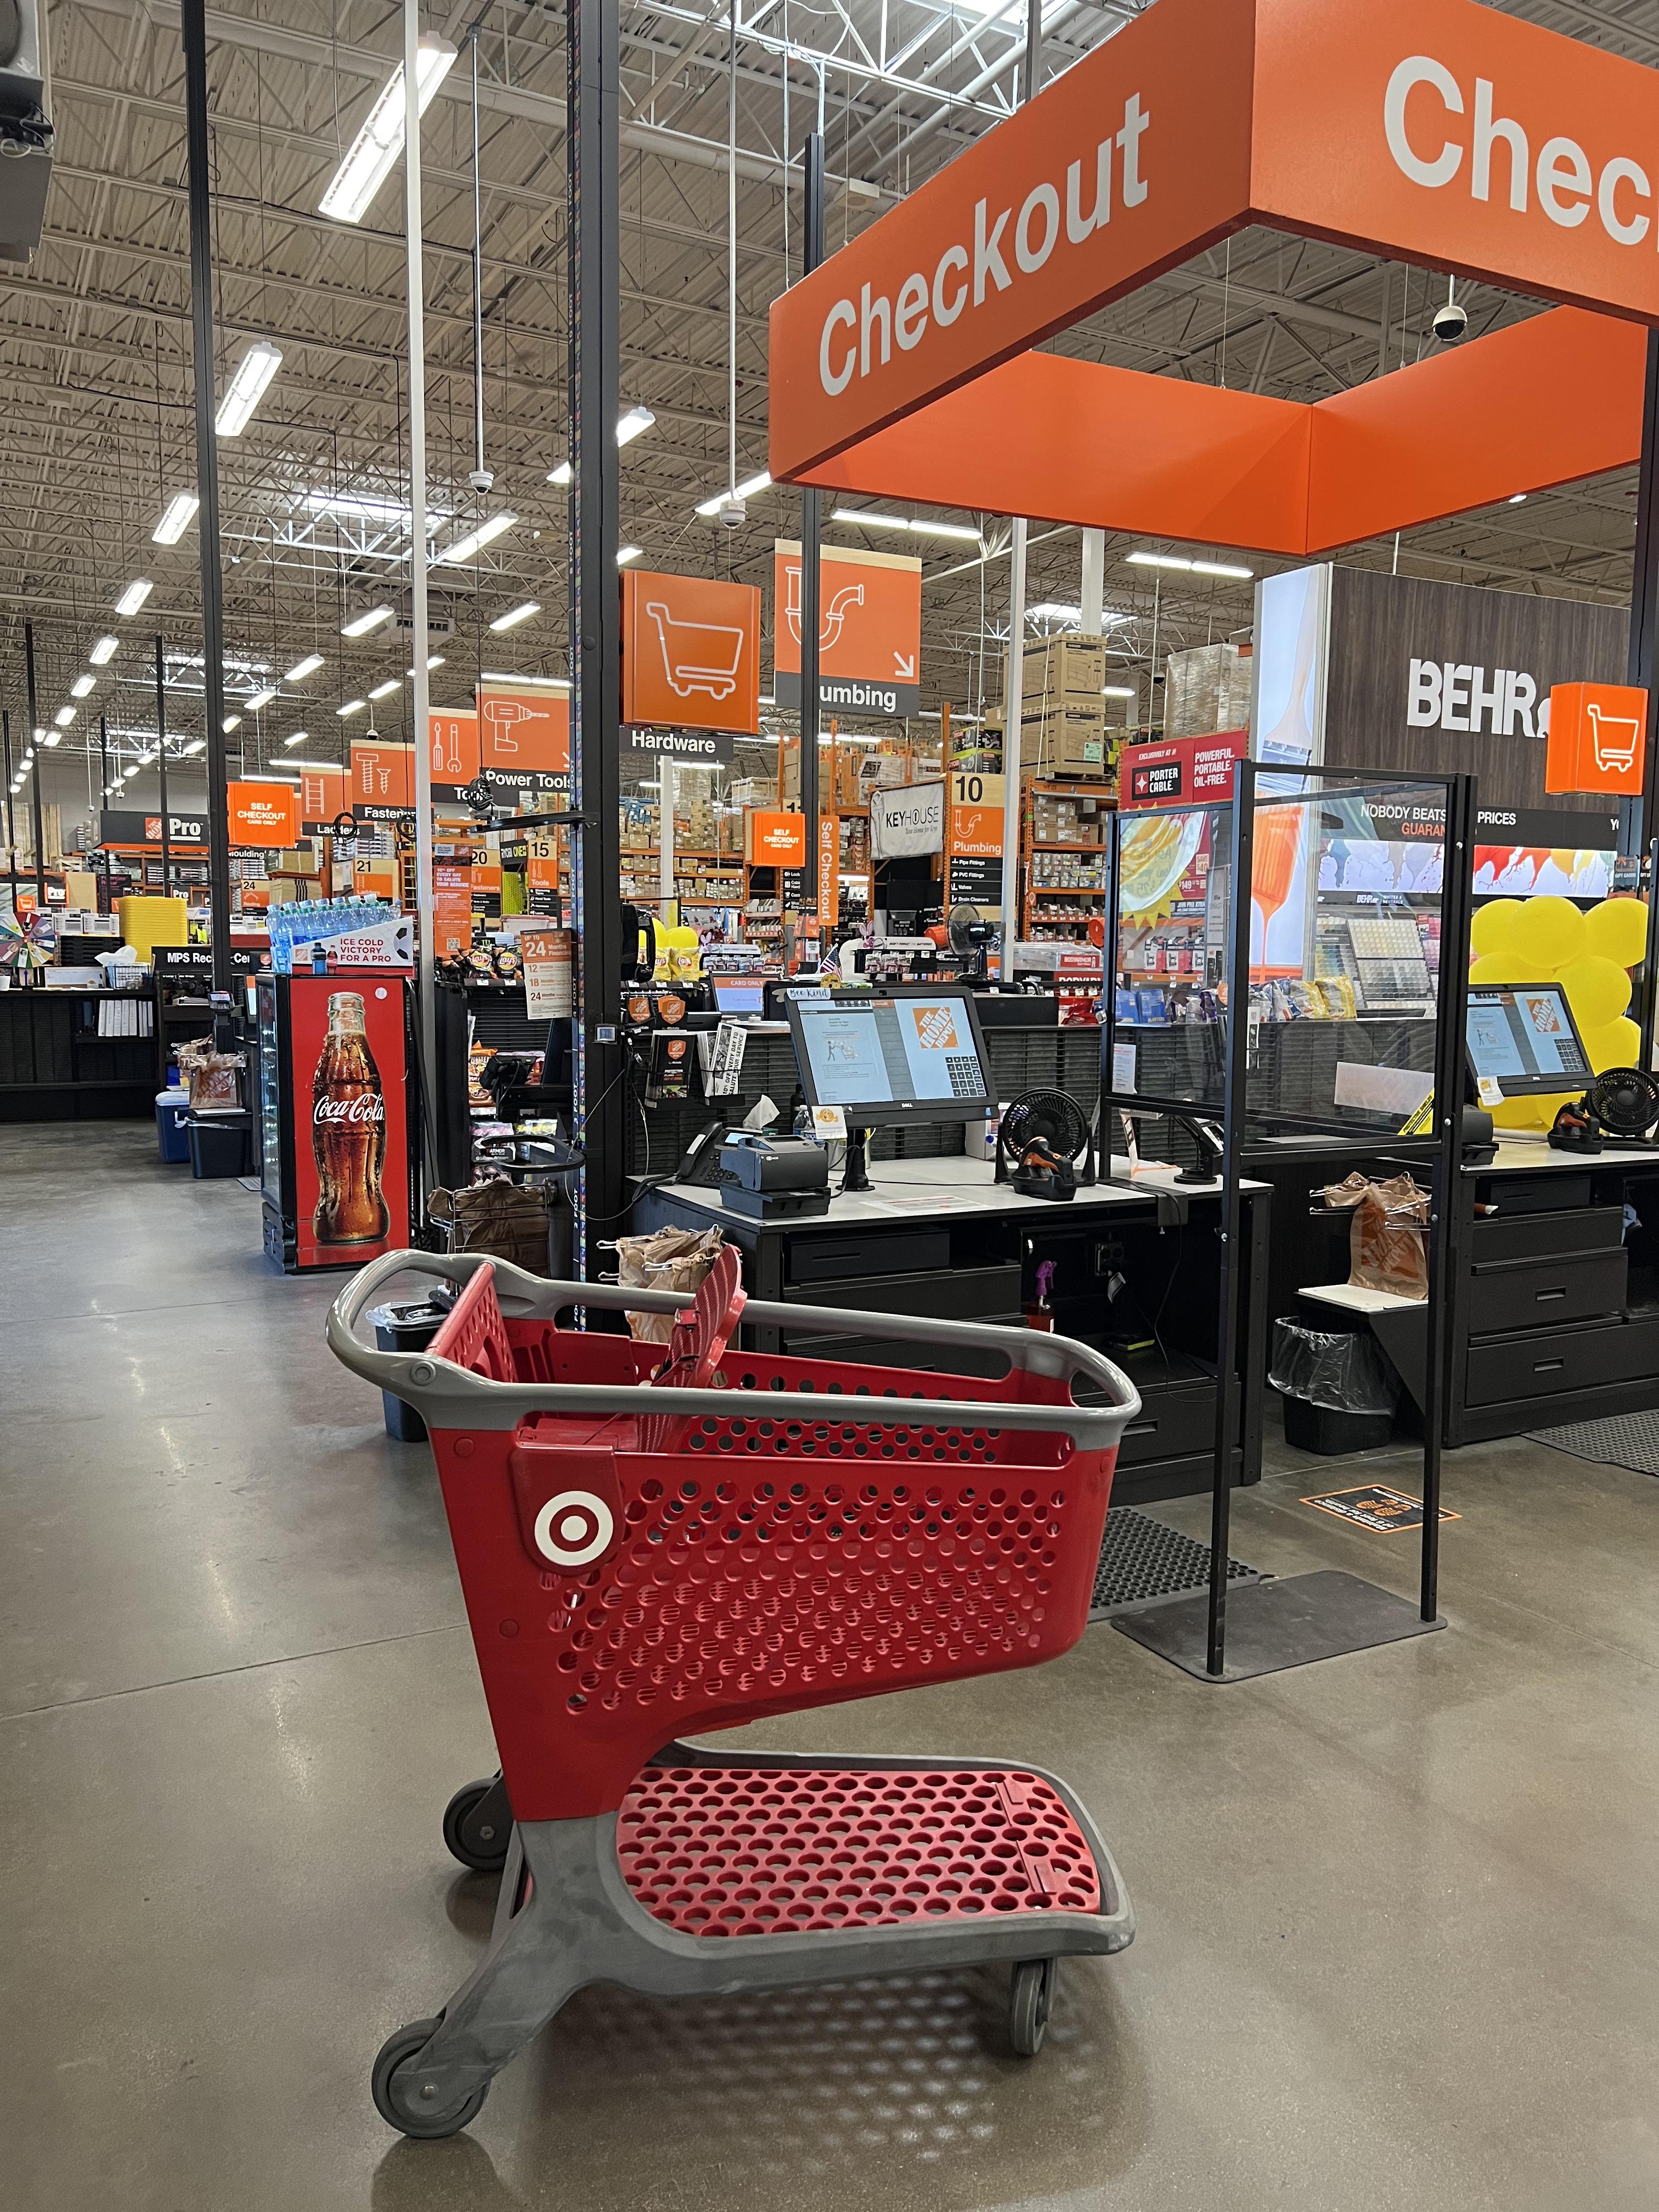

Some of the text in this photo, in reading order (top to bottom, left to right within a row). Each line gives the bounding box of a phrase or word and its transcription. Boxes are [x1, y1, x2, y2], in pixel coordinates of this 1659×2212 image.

[1384, 55, 1658, 248] Chec
[819, 92, 1150, 396] Checkout
[820, 684, 896, 712] umbing
[1407, 658, 1536, 737] BEHR
[631, 730, 716, 753] Hardware
[1138, 751, 1165, 760] EXCLUSIVELY
[1195, 748, 1234, 763] POWERFUL.
[1150, 768, 1178, 781] PORTER
[1194, 760, 1232, 775] PORTABLE.
[486, 771, 532, 786] Power
[1194, 773, 1227, 787] OIL-FREE.
[956, 776, 983, 802] 10
[251, 803, 272, 811] SELF
[1361, 804, 1516, 825] NOBODY BEATS PRICES
[237, 811, 285, 820] CHECKOUT
[886, 806, 939, 828] KEYHOUSE
[169, 818, 201, 836] Pro
[531, 842, 549, 857] 15
[954, 841, 1001, 855] Plumbing
[472, 851, 487, 864] 20
[357, 860, 371, 872] 21
[821, 822, 832, 919] Self Checkout
[244, 881, 255, 890] 24
[1179, 880, 1192, 890] $149
[173, 889, 189, 898] Pro
[526, 941, 546, 957] 24
[167, 952, 190, 963] MPS
[528, 964, 538, 973] 12
[529, 978, 539, 987] 18
[531, 992, 541, 1001] 24
[790, 988, 829, 997] Bee Kind
[919, 1011, 934, 1028] THE
[919, 1007, 952, 1048] HOME
[934, 1022, 955, 1048] DEPOT
[733, 1032, 738, 1041] TO
[729, 1075, 737, 1094] SALUTE
[314, 1093, 385, 1125] Coca-Cola
